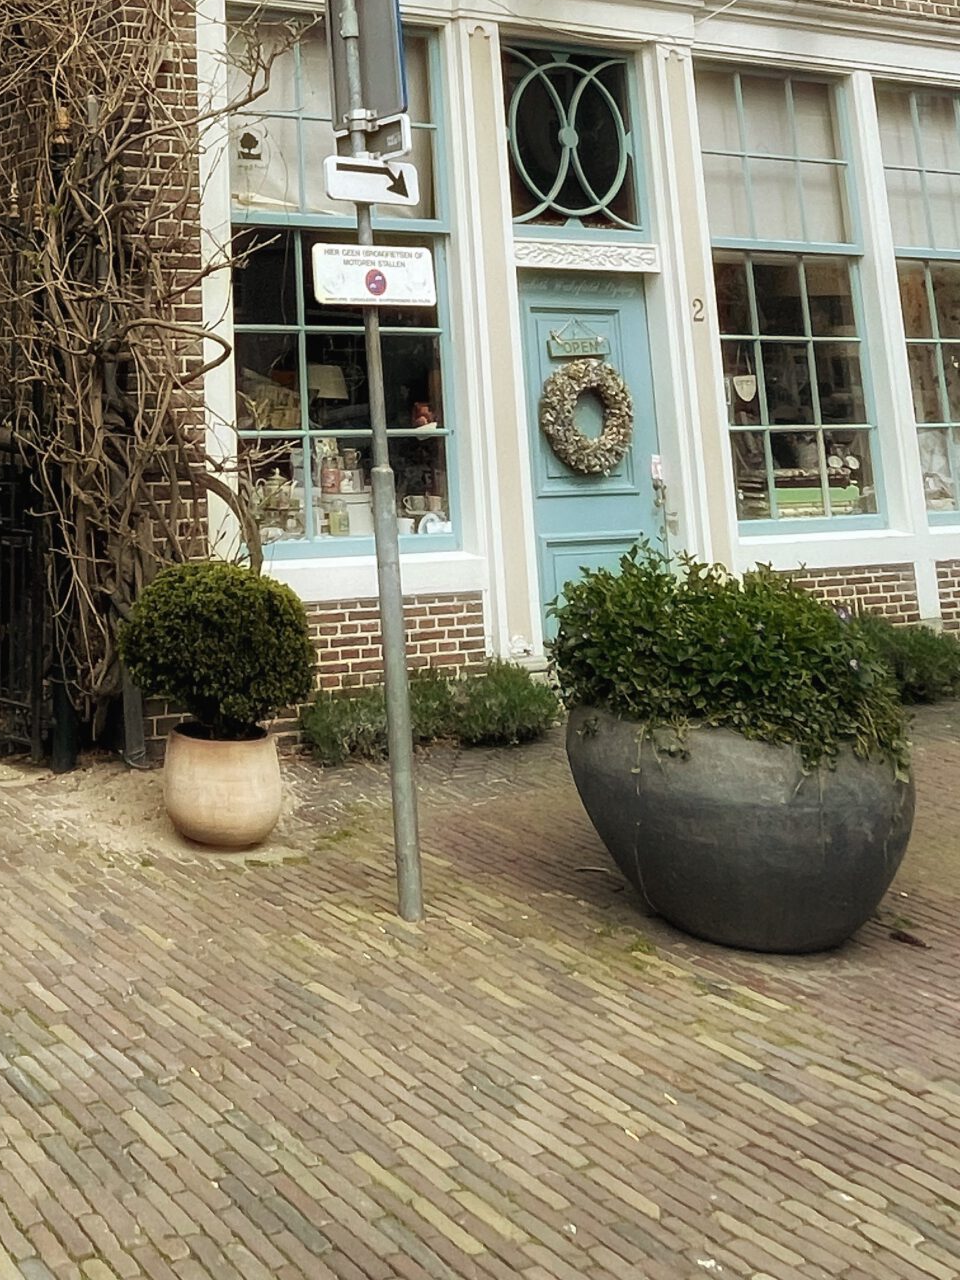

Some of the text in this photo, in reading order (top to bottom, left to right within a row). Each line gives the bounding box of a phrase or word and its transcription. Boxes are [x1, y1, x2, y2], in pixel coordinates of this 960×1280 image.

[324, 248, 340, 256] HIER
[342, 249, 360, 257] GEEN
[415, 251, 424, 259] OF
[343, 259, 406, 268] MOTOREN STALLEN
[692, 298, 705, 322] 2
[564, 341, 598, 353] OPEN
